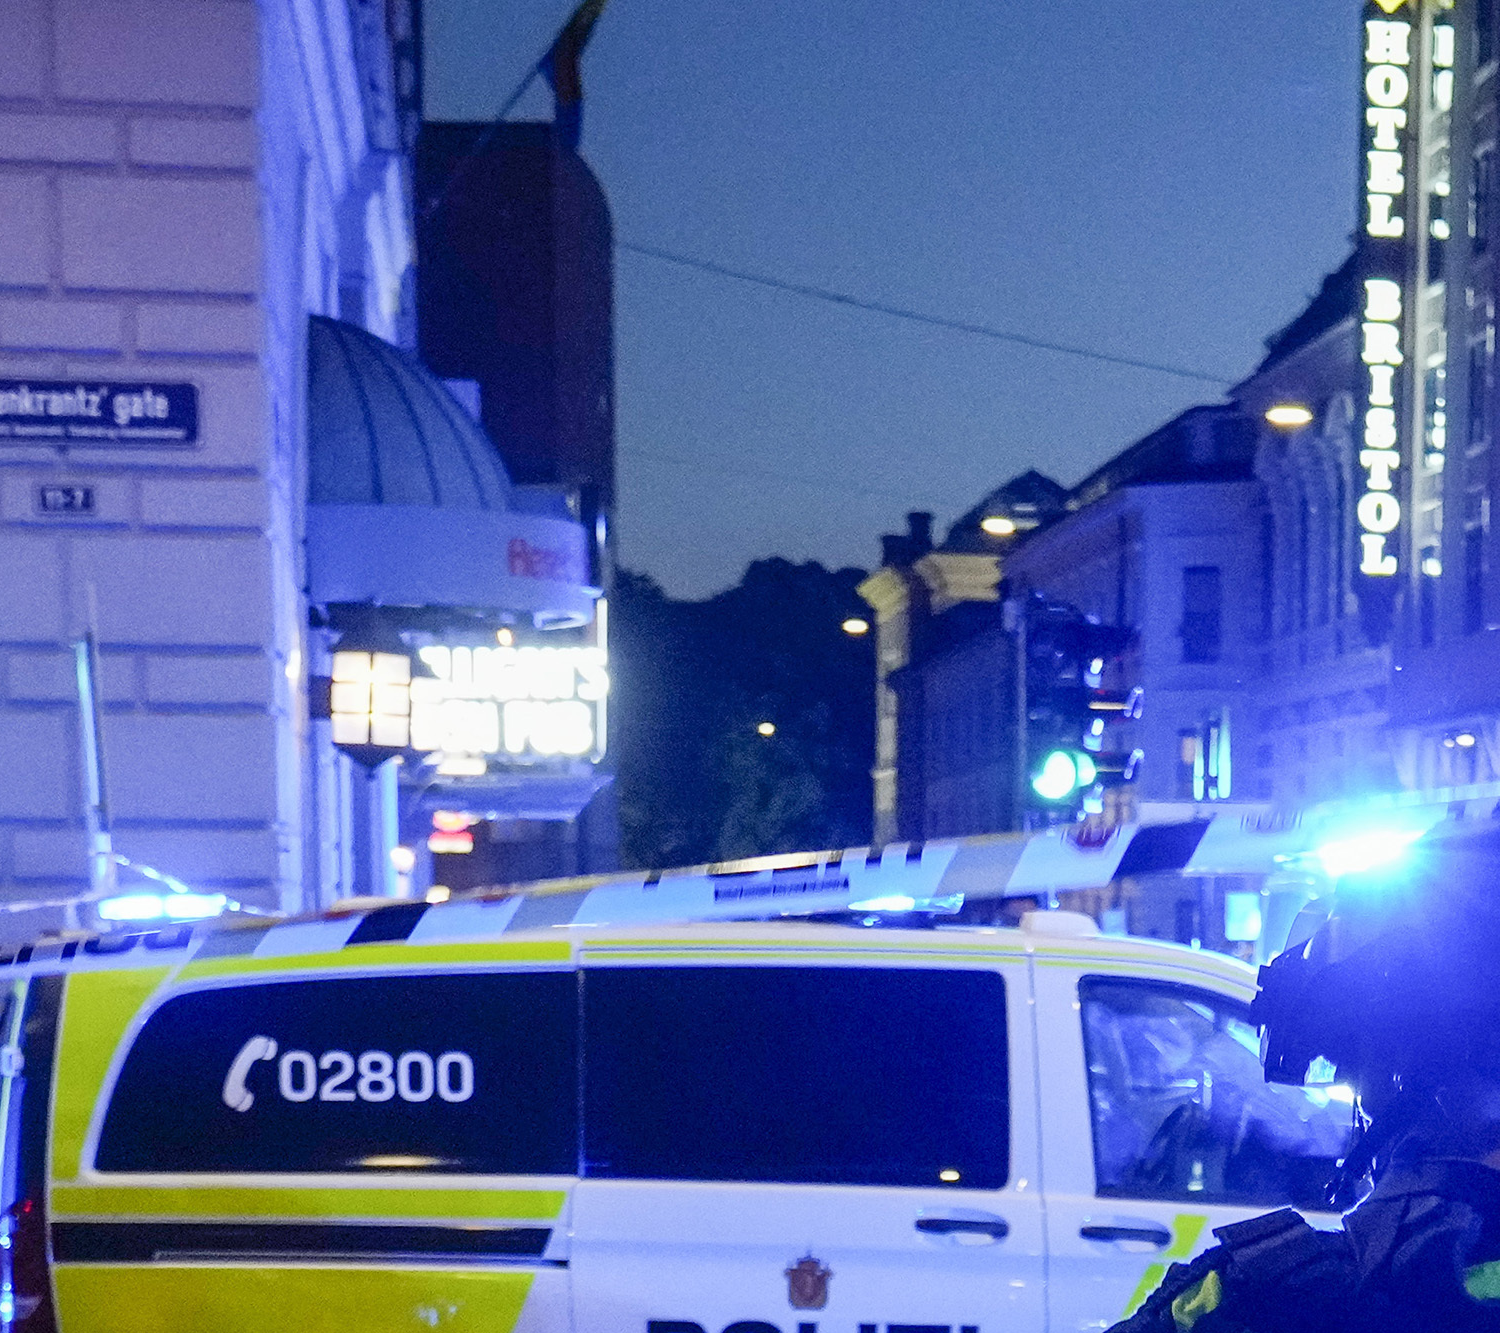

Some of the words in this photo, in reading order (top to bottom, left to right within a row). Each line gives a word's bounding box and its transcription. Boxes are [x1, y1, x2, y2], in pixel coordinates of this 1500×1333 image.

[1365, 19, 1411, 238] HOTEL
[112, 389, 169, 426] gate
[1357, 278, 1404, 576] BRISTOL
[278, 1050, 476, 1104] 02800
